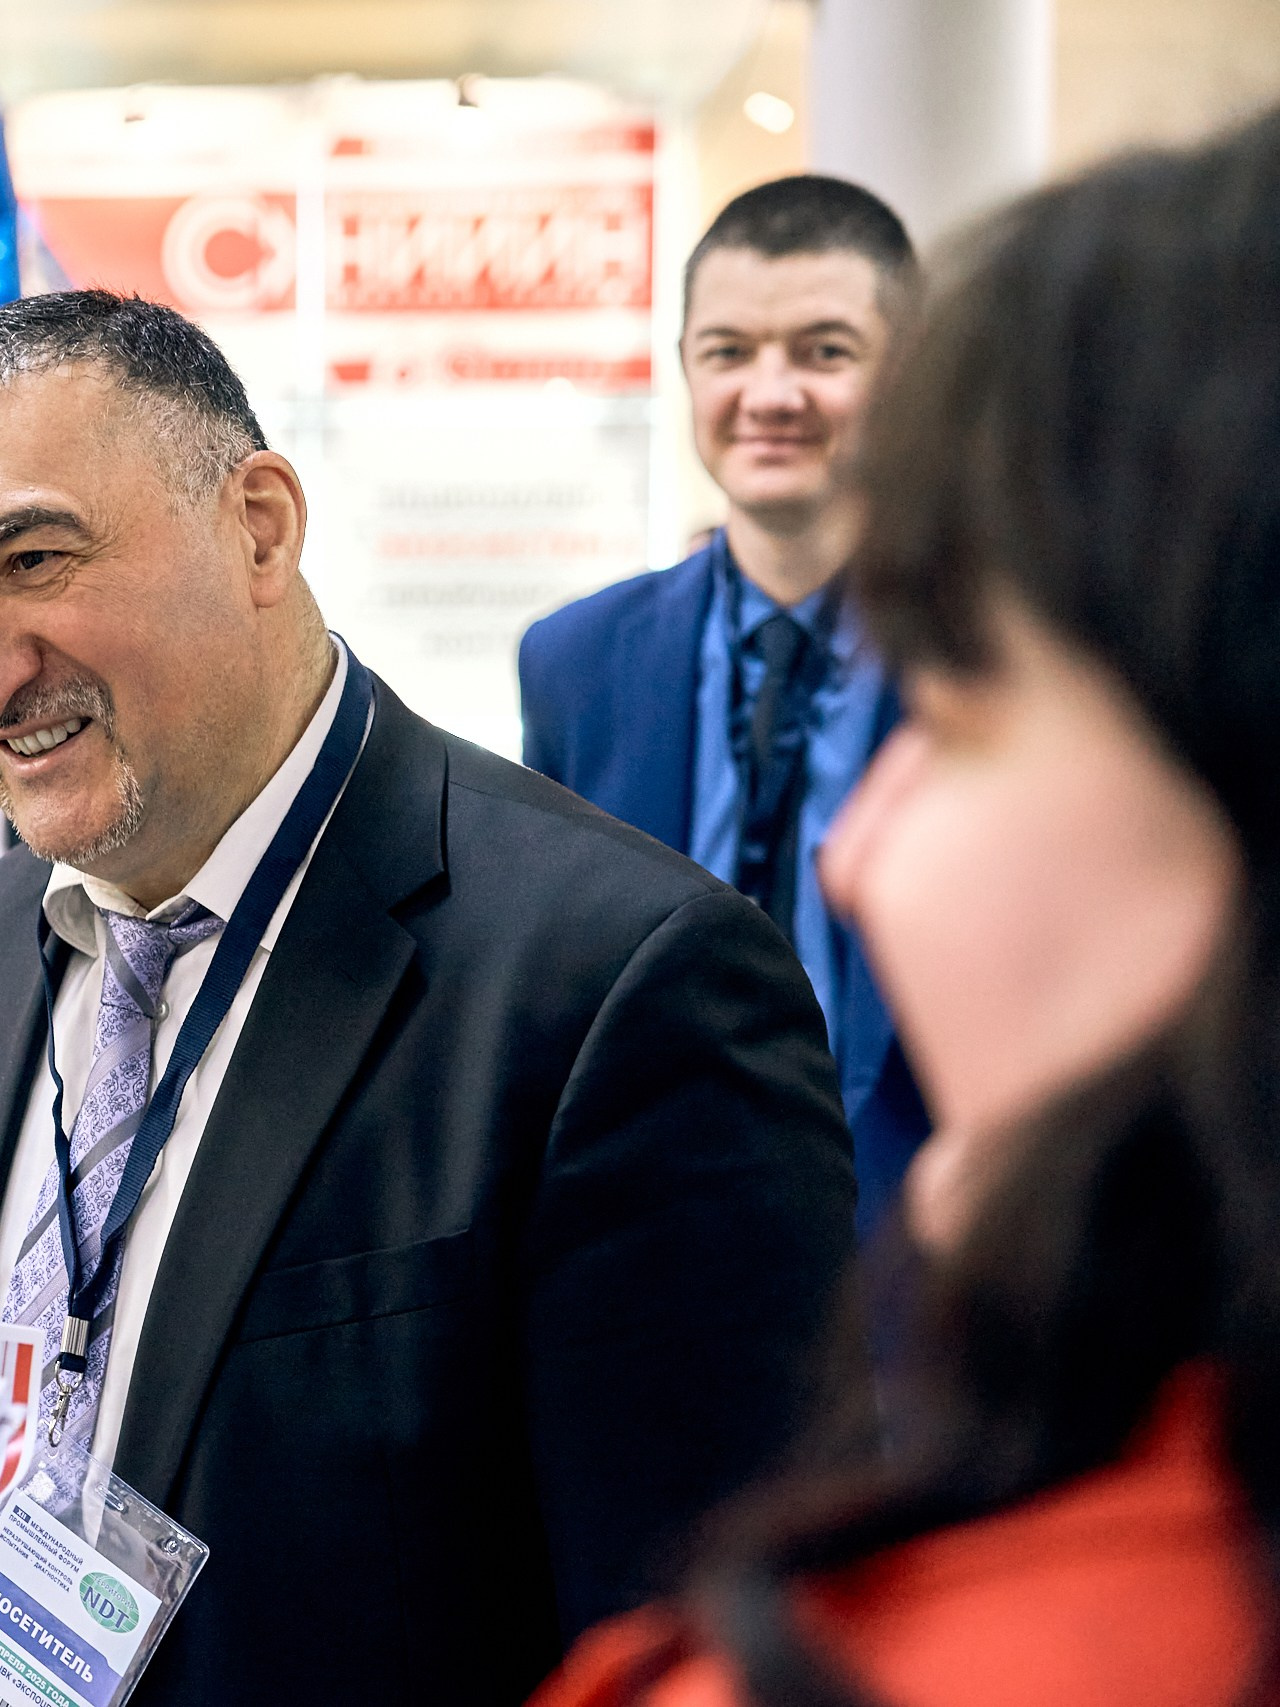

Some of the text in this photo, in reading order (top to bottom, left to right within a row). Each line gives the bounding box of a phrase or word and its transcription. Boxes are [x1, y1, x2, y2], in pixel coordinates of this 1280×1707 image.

[0, 1533, 70, 1593] ИСПЫТАНИЯ ДИАГНОСТИКА
[2, 1526, 73, 1586] НЕРАЗРУШАЮЩИЙ КОНТРОЛЬ
[9, 1514, 80, 1574] ПРОМЫШЛЕННЫЙ ФОРУМ
[30, 1520, 83, 1566] МЕЖДУНАРОДНЫЙ
[82, 1586, 130, 1629] NDT
[25, 1669, 47, 1690] 2025
[46, 1685, 70, 1707] ГОДА
